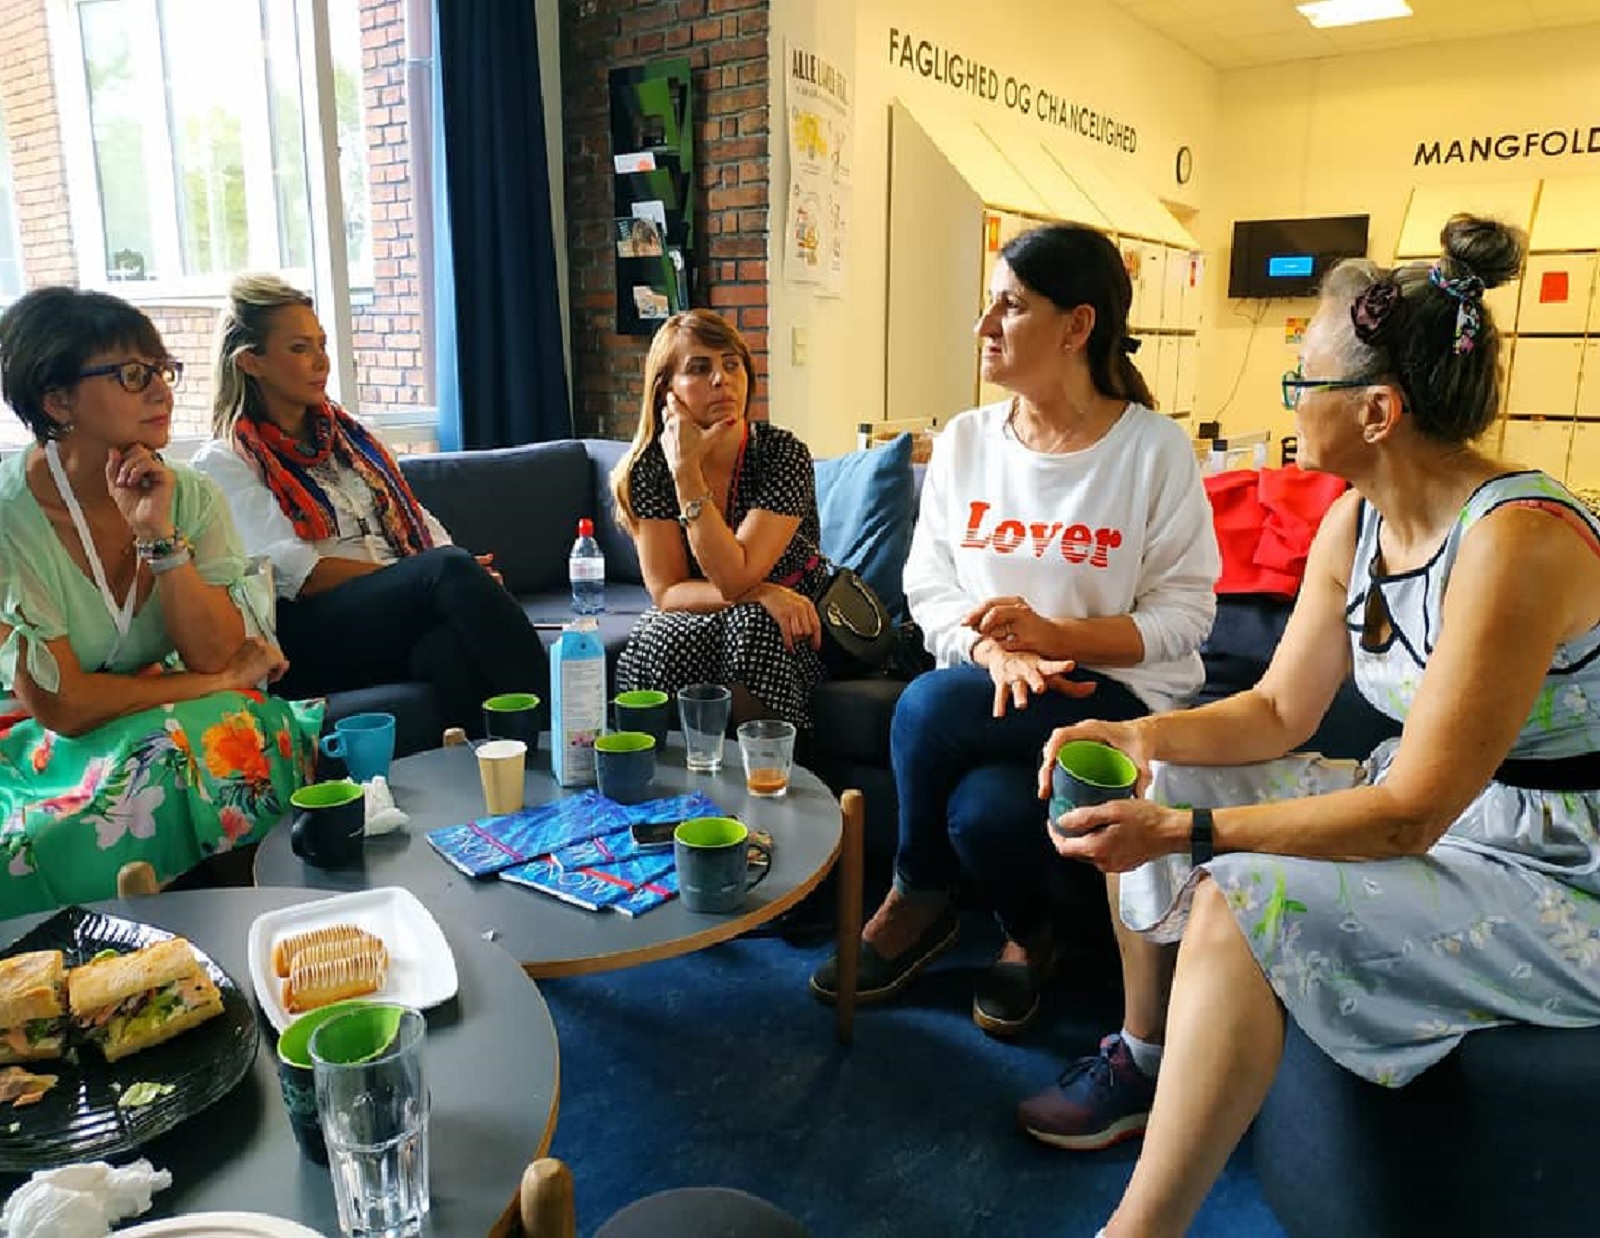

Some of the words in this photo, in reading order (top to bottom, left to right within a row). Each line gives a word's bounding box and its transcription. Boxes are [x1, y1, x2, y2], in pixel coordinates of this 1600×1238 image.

[889, 27, 999, 102] FAGLIGHED
[1004, 76, 1031, 115] OG
[1036, 89, 1137, 154] CHANCELIGHED
[961, 501, 1122, 568] Lover
